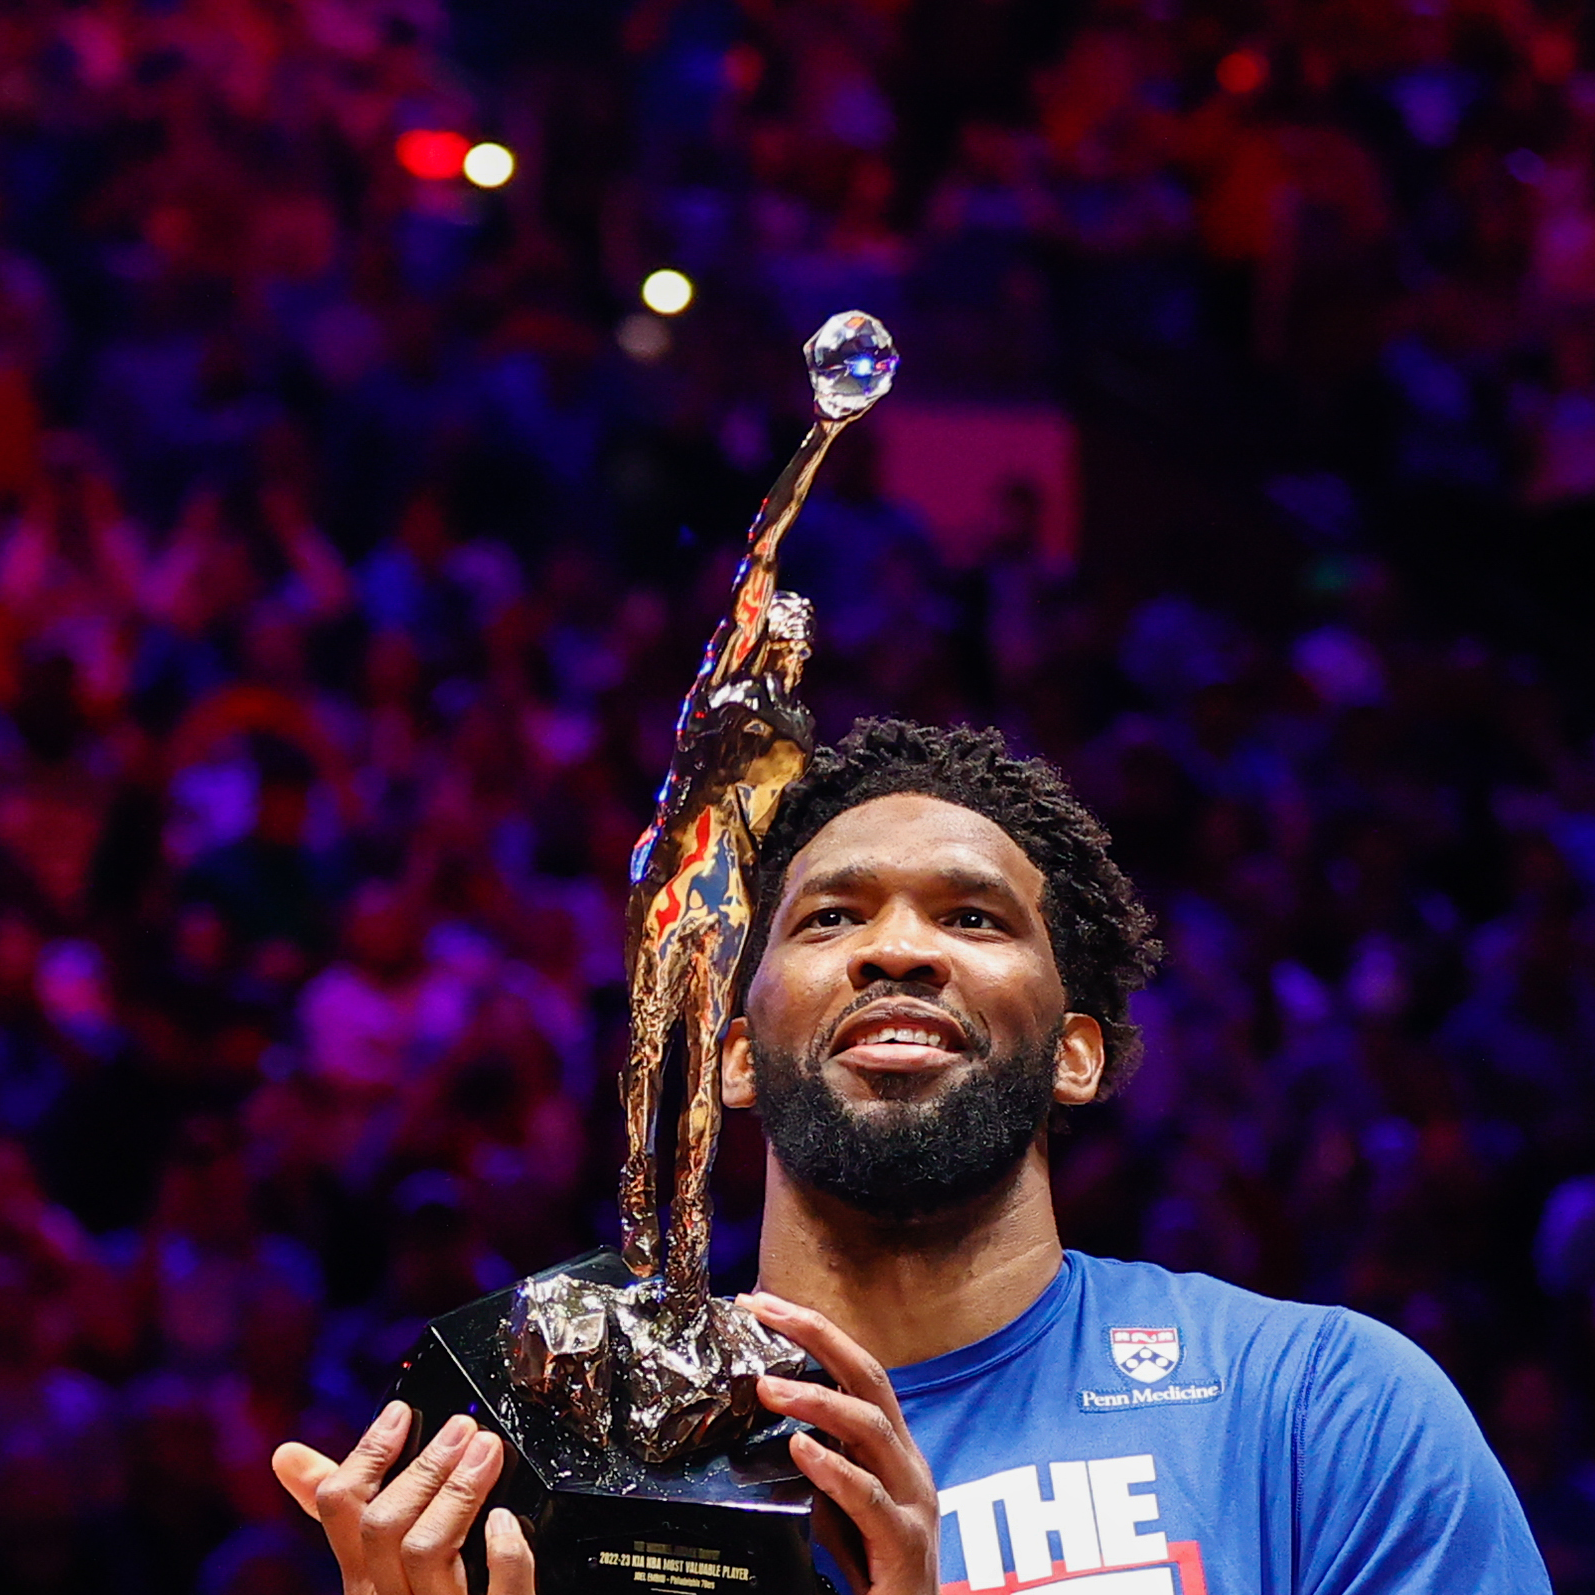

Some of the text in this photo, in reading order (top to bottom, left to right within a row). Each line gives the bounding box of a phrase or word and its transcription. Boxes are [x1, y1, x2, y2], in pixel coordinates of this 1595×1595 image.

[1082, 1384, 1219, 1407] Penn Medicine
[937, 1454, 1169, 1591] THE
[599, 1551, 631, 1567] 2022-23
[632, 1554, 645, 1568] KIA
[663, 1558, 684, 1573] MOST
[685, 1561, 721, 1577] VALUABLE
[722, 1565, 749, 1581] PLAYER
